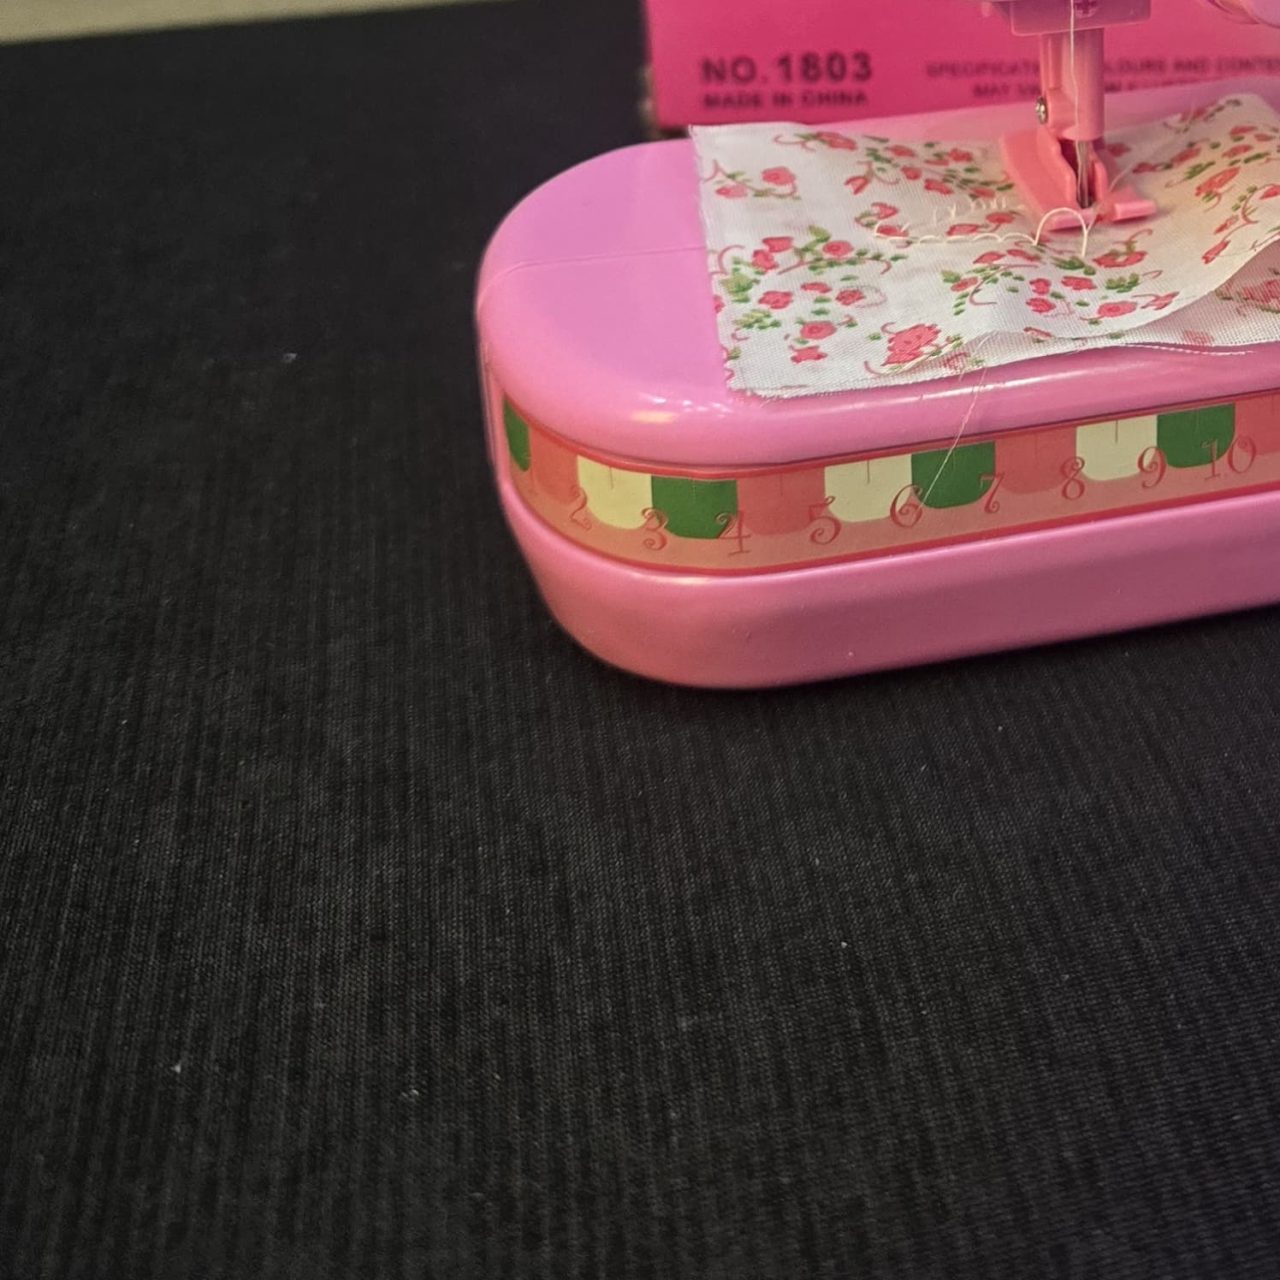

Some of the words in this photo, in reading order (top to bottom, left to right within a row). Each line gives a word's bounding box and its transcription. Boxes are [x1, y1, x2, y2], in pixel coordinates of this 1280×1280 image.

[704, 91, 762, 109] MADE
[801, 88, 868, 107] CHINA
[569, 484, 593, 531] 2
[641, 506, 669, 552] 3
[715, 509, 752, 556] 4
[808, 495, 842, 545] 5
[890, 483, 924, 529] 6
[979, 471, 1007, 514] 7
[1059, 455, 1087, 500] 8
[1137, 445, 1168, 489] 9
[1200, 434, 1258, 481] 10
